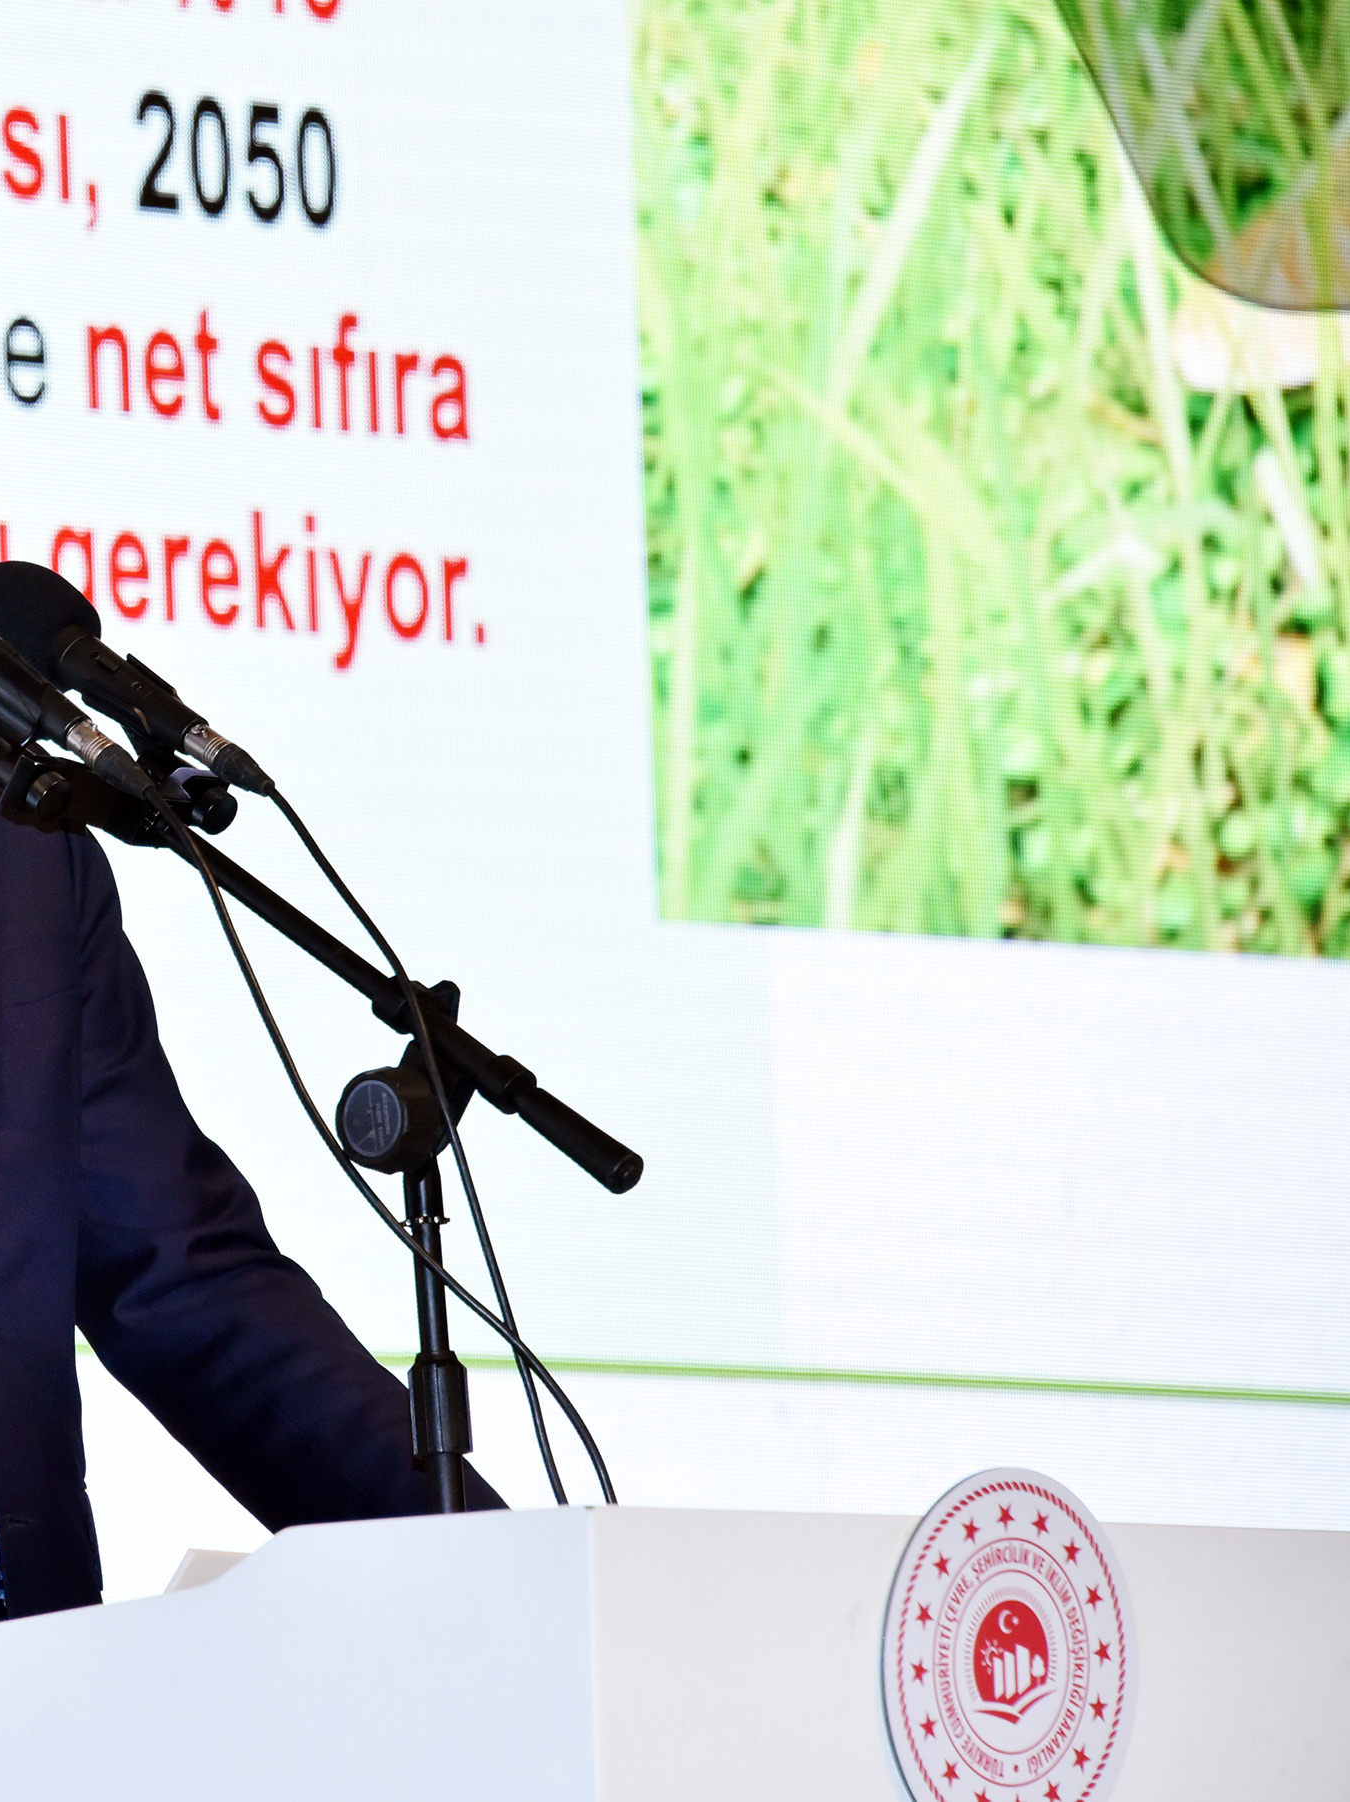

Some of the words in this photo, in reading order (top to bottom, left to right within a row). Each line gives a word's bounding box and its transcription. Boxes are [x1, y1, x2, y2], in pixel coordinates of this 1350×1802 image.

[136, 90, 338, 228] 2050
[85, 309, 222, 422] net
[255, 312, 471, 442] sıfıra
[50, 511, 486, 671] gerekiyor.
[1032, 1553, 1045, 1574] VE
[1065, 1606, 1086, 1709] DEĞİŞİKLİĞİ
[1027, 1708, 1077, 1777] BAKANLIĞI
